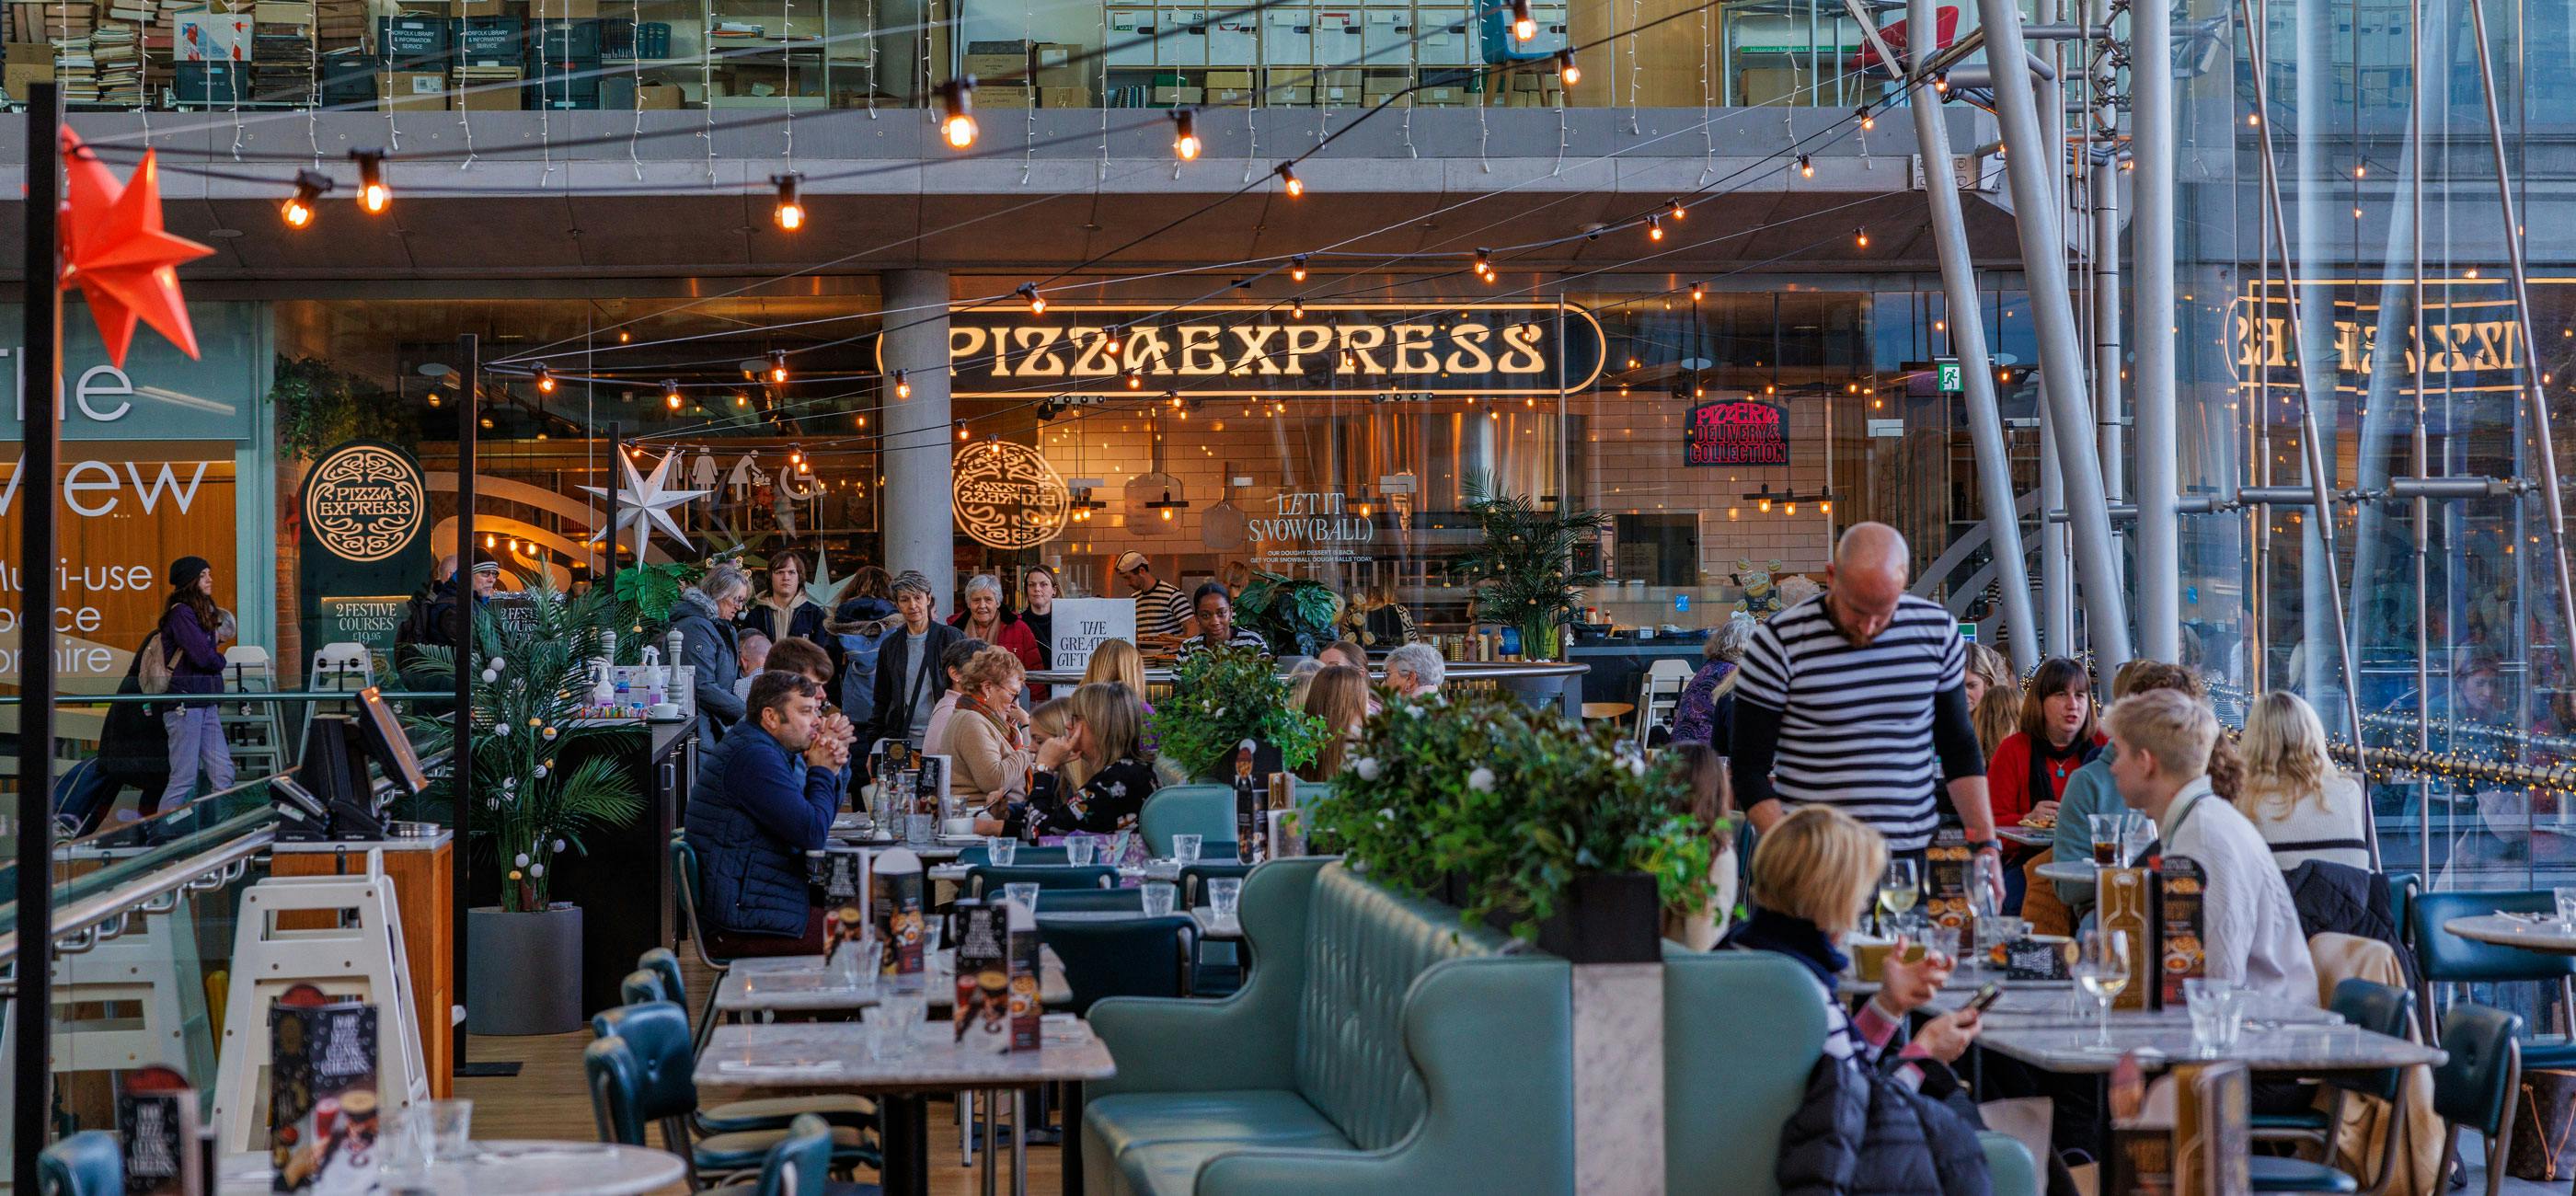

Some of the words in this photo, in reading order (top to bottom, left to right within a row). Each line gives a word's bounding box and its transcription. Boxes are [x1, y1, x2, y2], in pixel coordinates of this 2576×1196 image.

[949, 323, 1547, 376] PIZZAEXPRESS
[1696, 402, 1780, 424] PIZZERIA
[1695, 423, 1767, 443] DELIVERY
[1767, 423, 1781, 443] &
[1689, 443, 1787, 464] COLLECTION
[336, 487, 395, 501] PIZZA
[319, 501, 411, 516] EXPRESS
[1276, 492, 1320, 515] LET
[1323, 492, 1346, 515] IT
[336, 603, 344, 617] 2
[345, 603, 397, 617] FESTIVE
[339, 617, 395, 631] COURSES
[1079, 621, 1107, 635] THE
[352, 631, 382, 645] £19.95
[1056, 652, 1087, 667] GIFT
